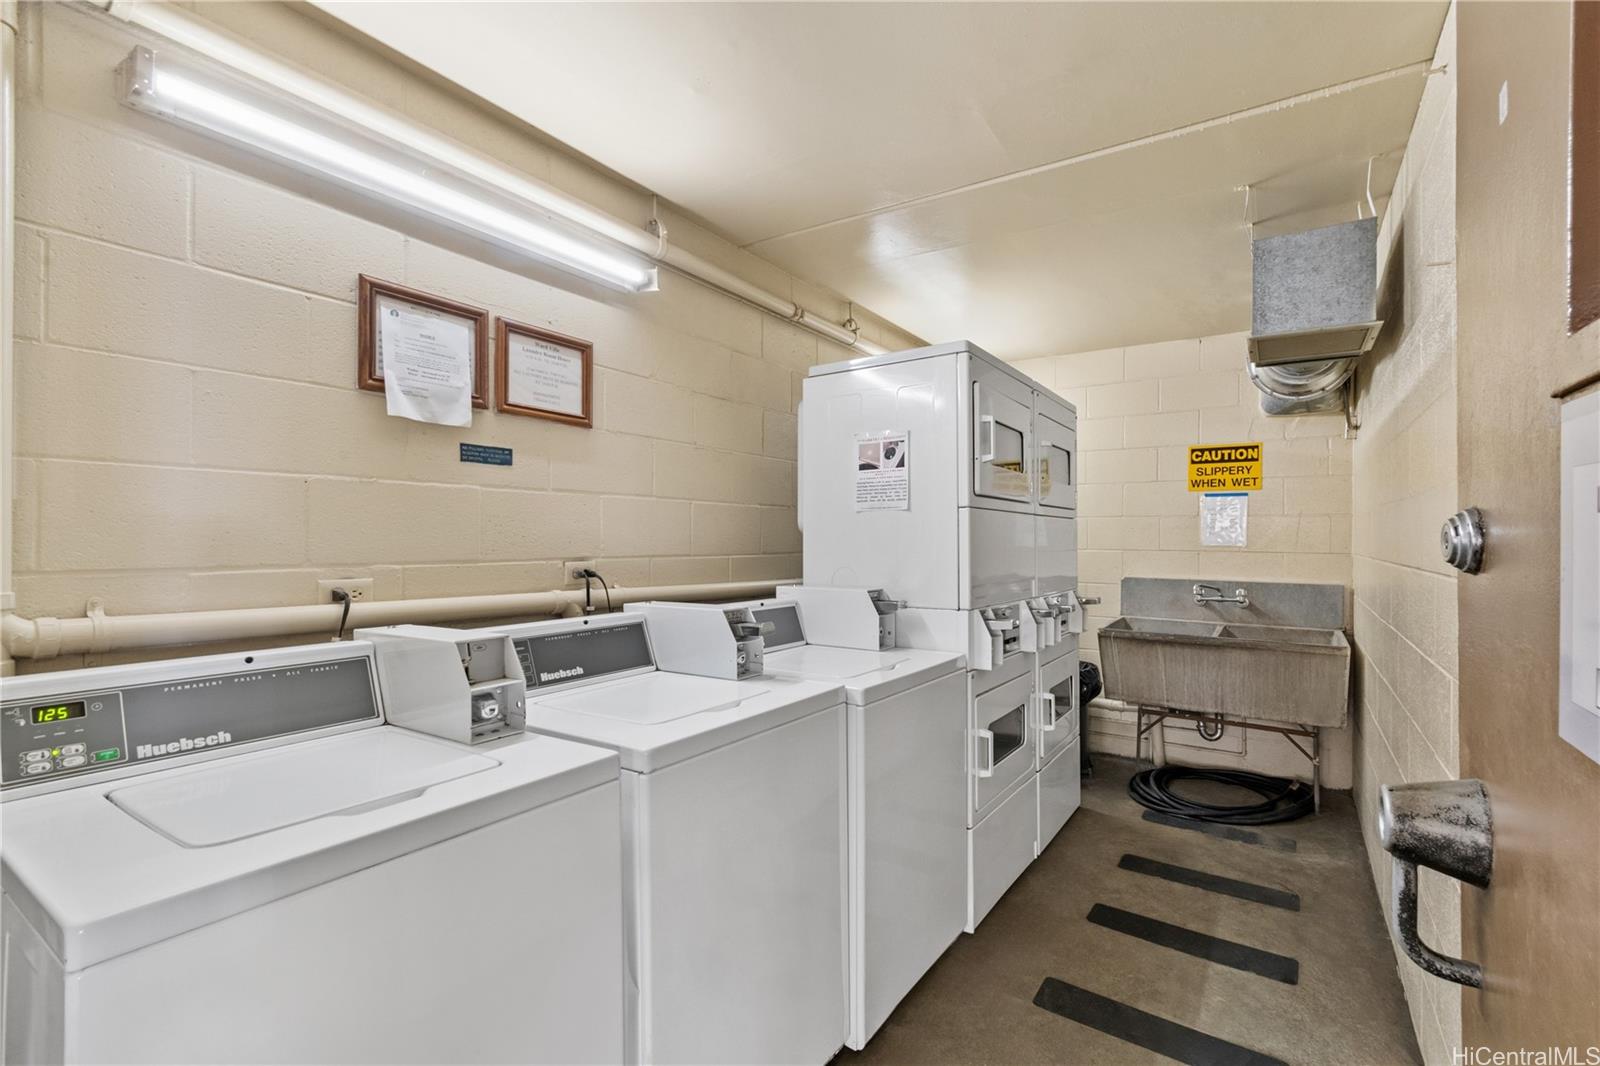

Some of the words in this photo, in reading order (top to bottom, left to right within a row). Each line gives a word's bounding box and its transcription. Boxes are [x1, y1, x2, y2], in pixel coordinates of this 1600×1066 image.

[1191, 449, 1258, 462] CAUTION
[1196, 466, 1253, 476] SLIPPERY
[1191, 478, 1226, 488] WHEN
[1231, 477, 1259, 487] WET
[540, 666, 584, 682] Huebsch
[163, 679, 223, 693] PERMANENT
[233, 674, 262, 684] PRESS
[37, 706, 68, 722] 125
[136, 731, 232, 759] Huebsch
